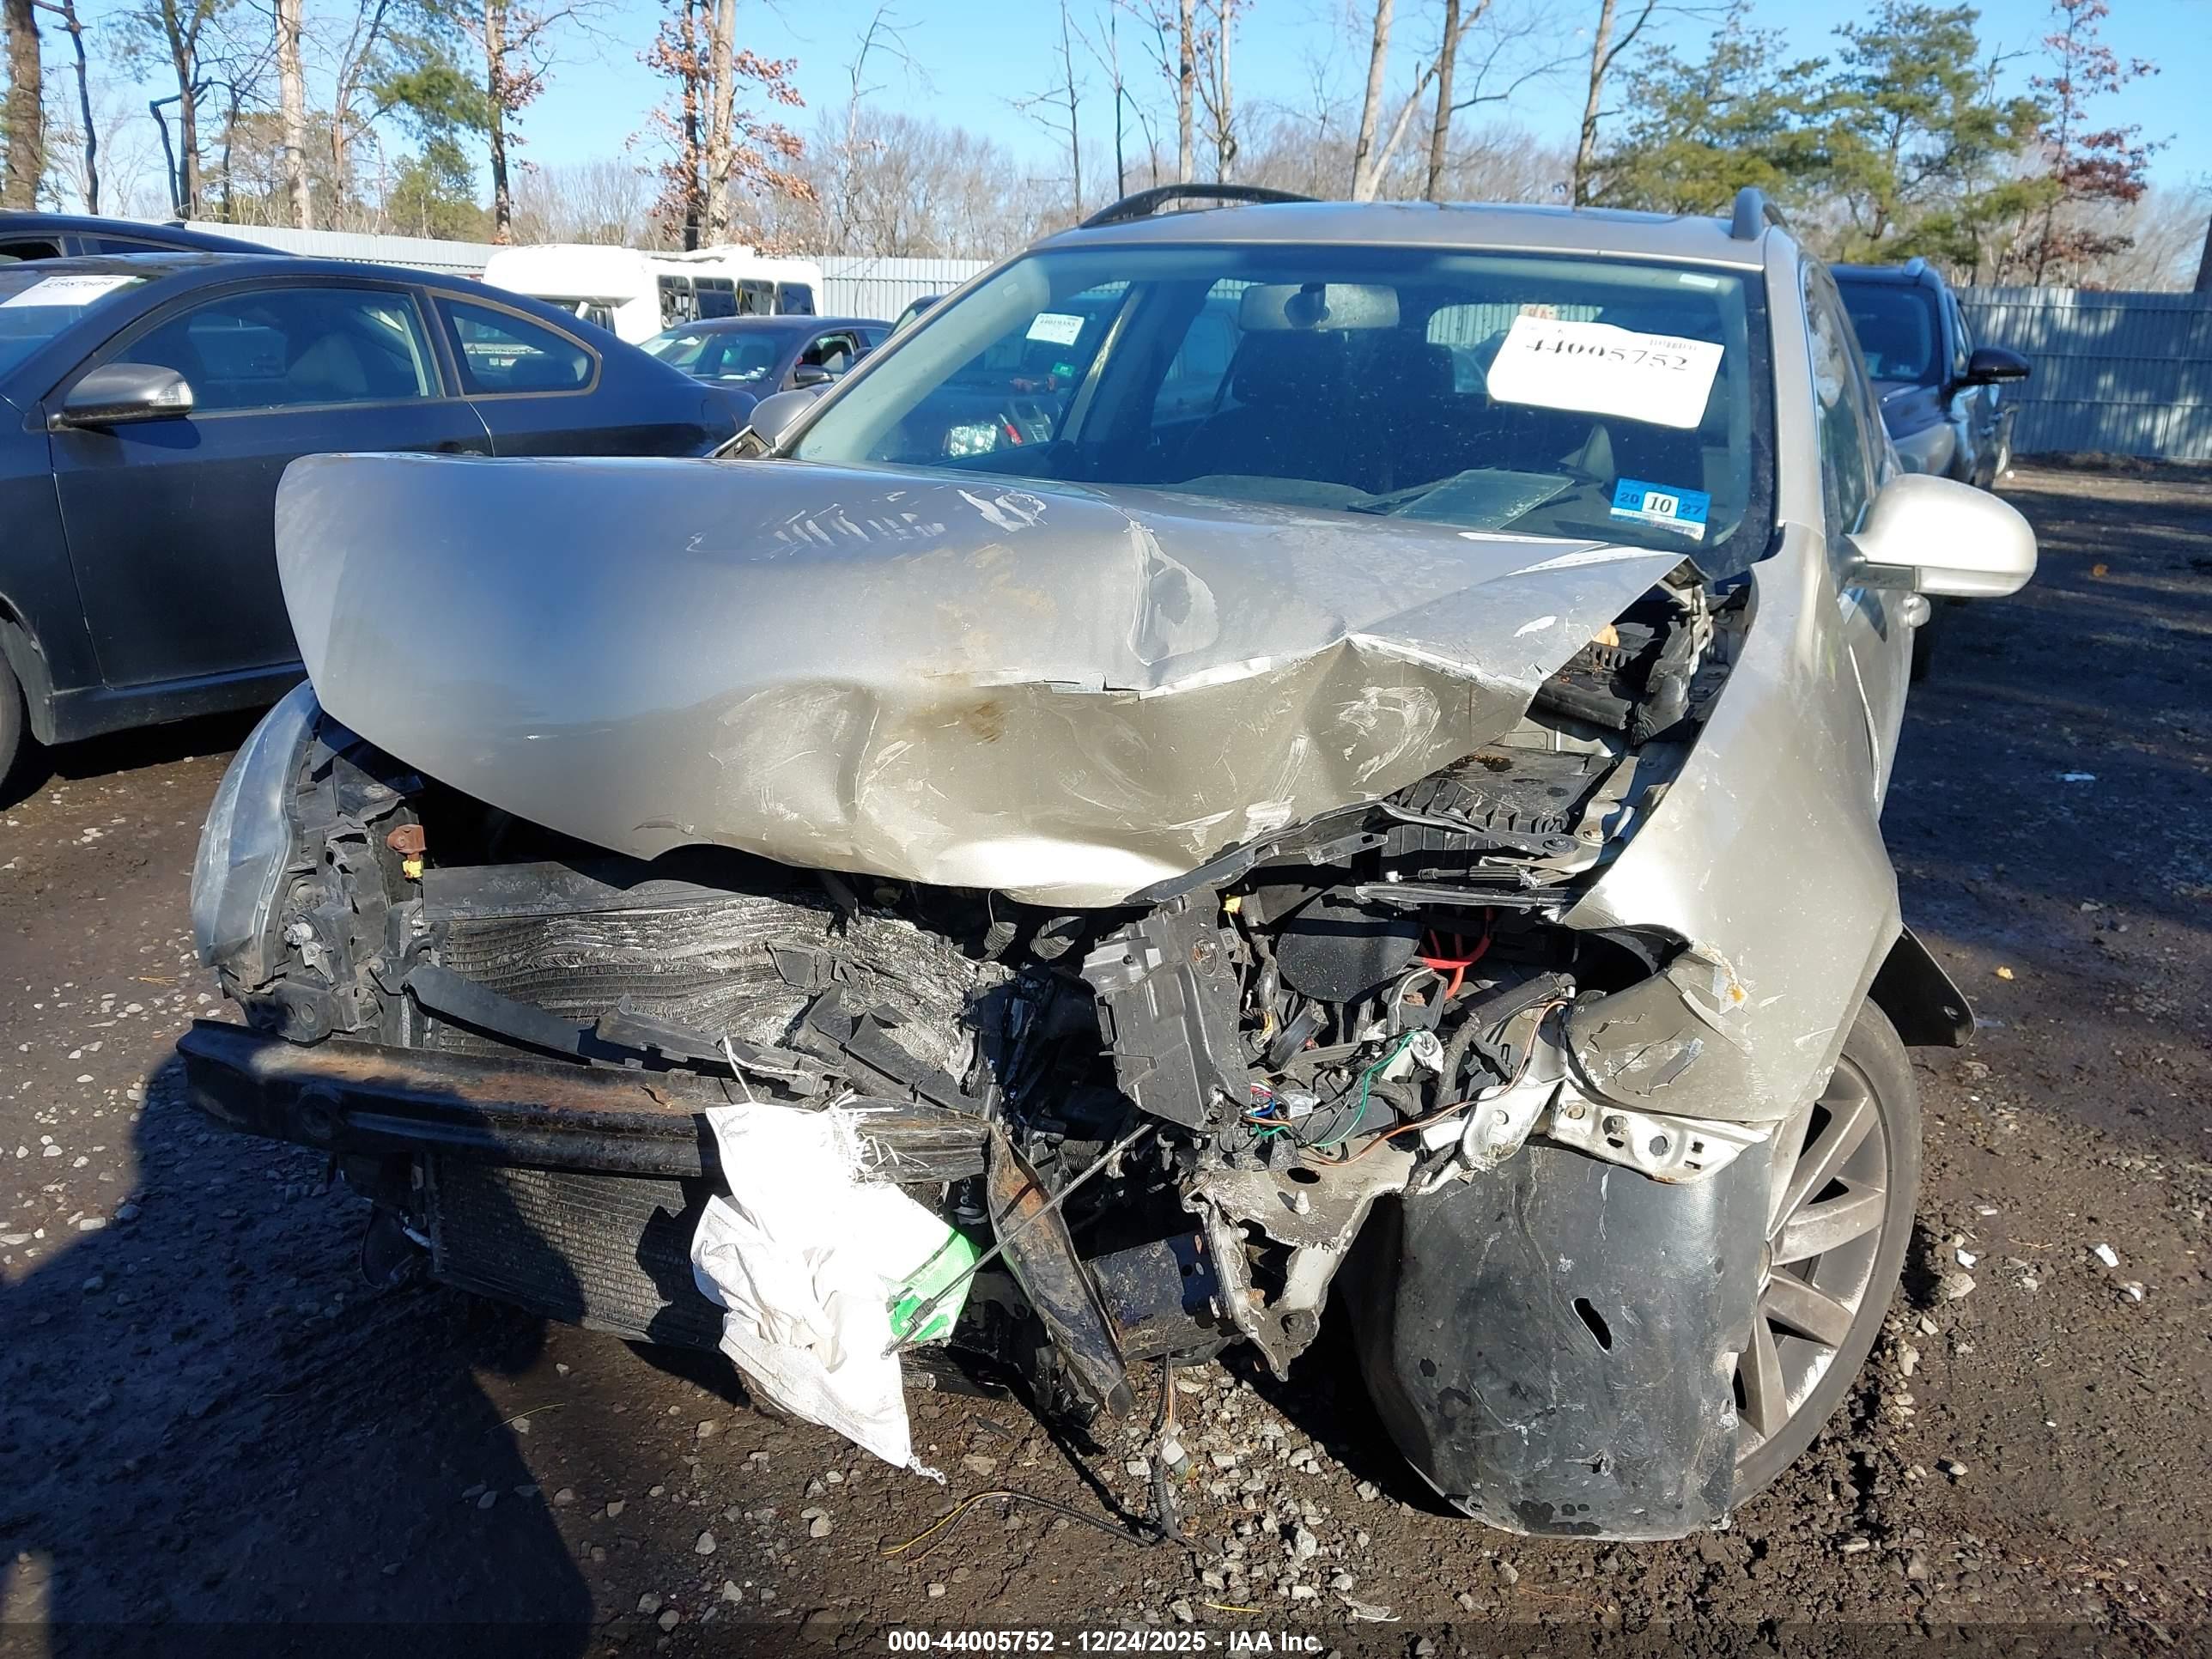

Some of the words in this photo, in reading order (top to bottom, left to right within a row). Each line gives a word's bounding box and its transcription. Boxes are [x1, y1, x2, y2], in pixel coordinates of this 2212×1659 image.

[1526, 339, 1687, 371] 44005752
[1620, 493, 1639, 504] 20
[1649, 495, 1672, 514] 10
[1680, 503, 1704, 514] 27
